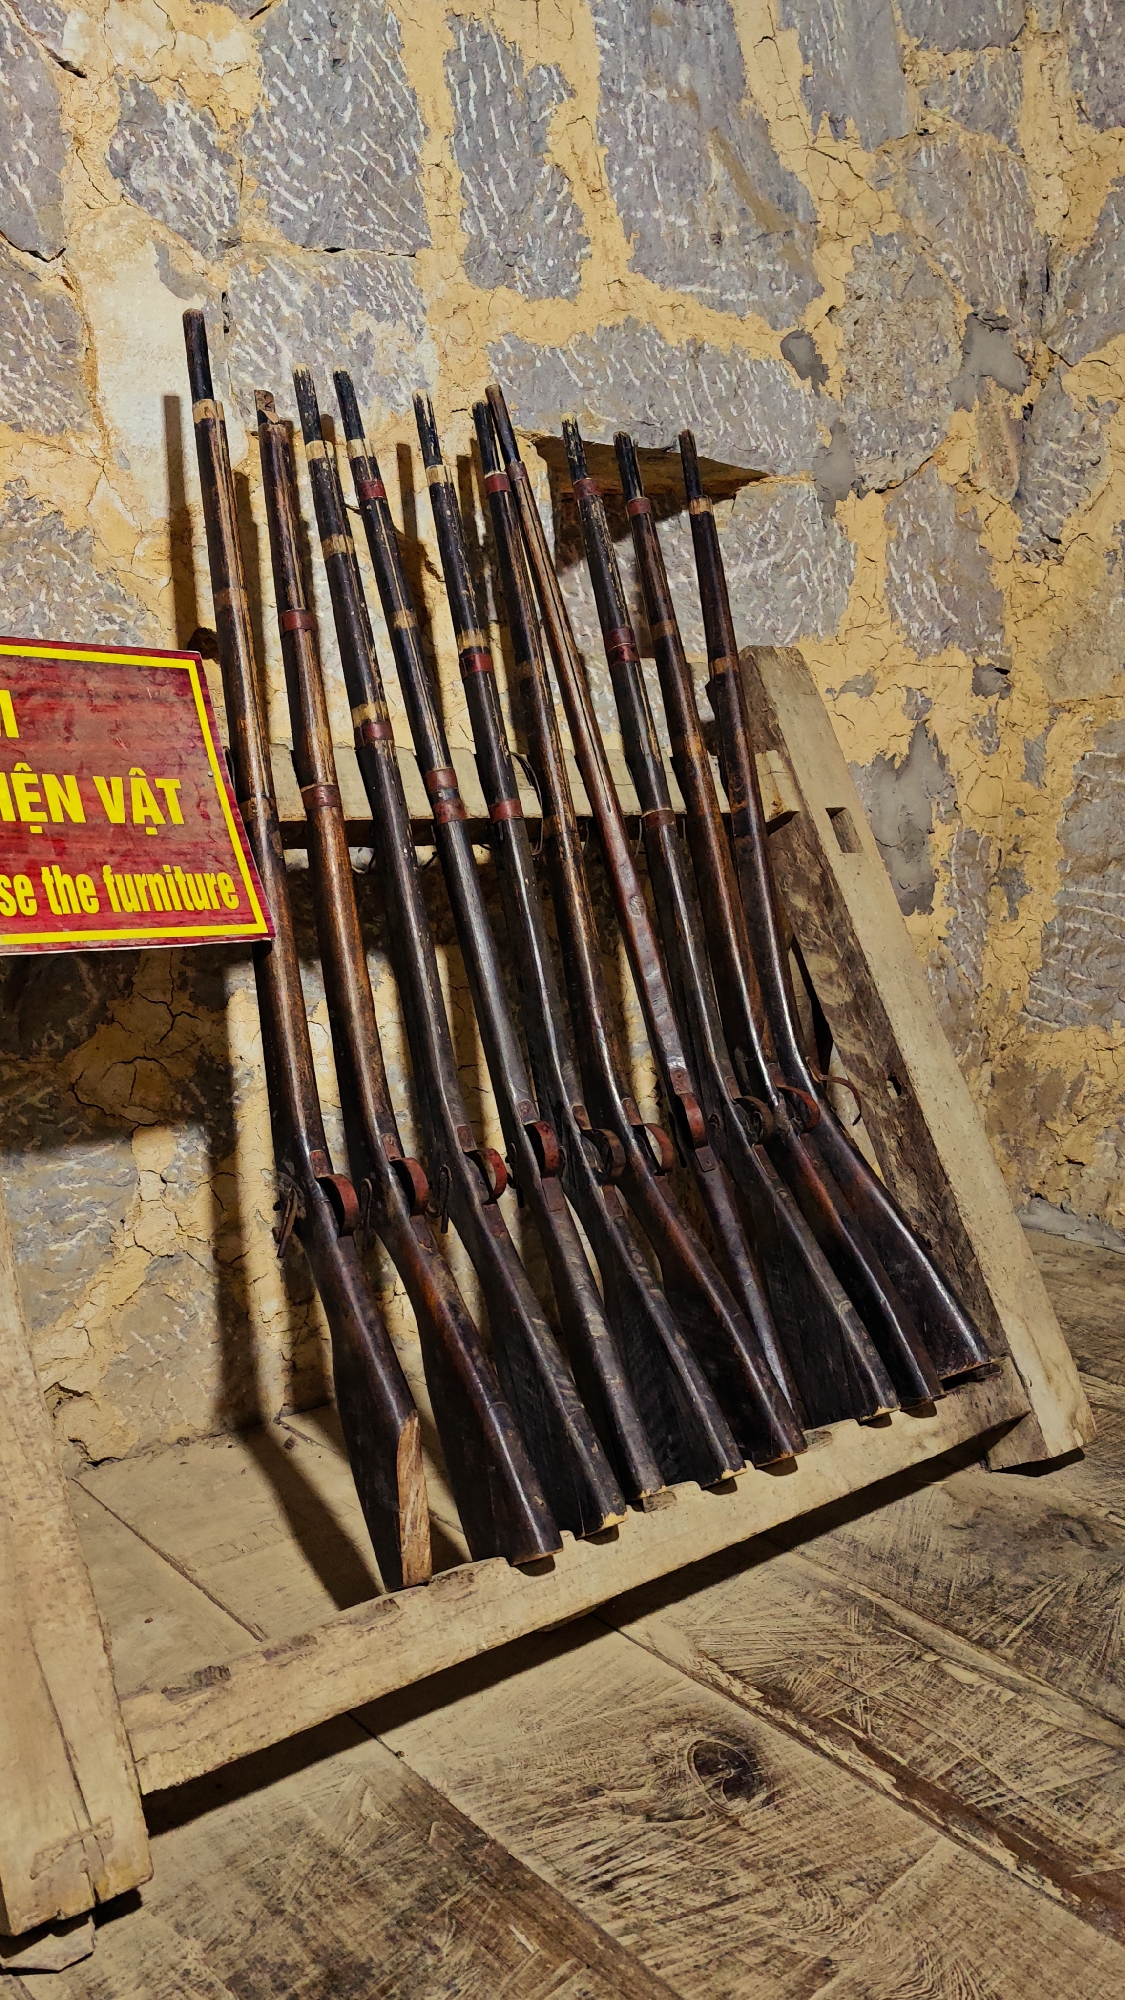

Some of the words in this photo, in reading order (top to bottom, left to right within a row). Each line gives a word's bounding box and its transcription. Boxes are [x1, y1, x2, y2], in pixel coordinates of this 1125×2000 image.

[92, 767, 185, 836] VẬT
[40, 864, 100, 916] the
[102, 864, 240, 913] furniture
